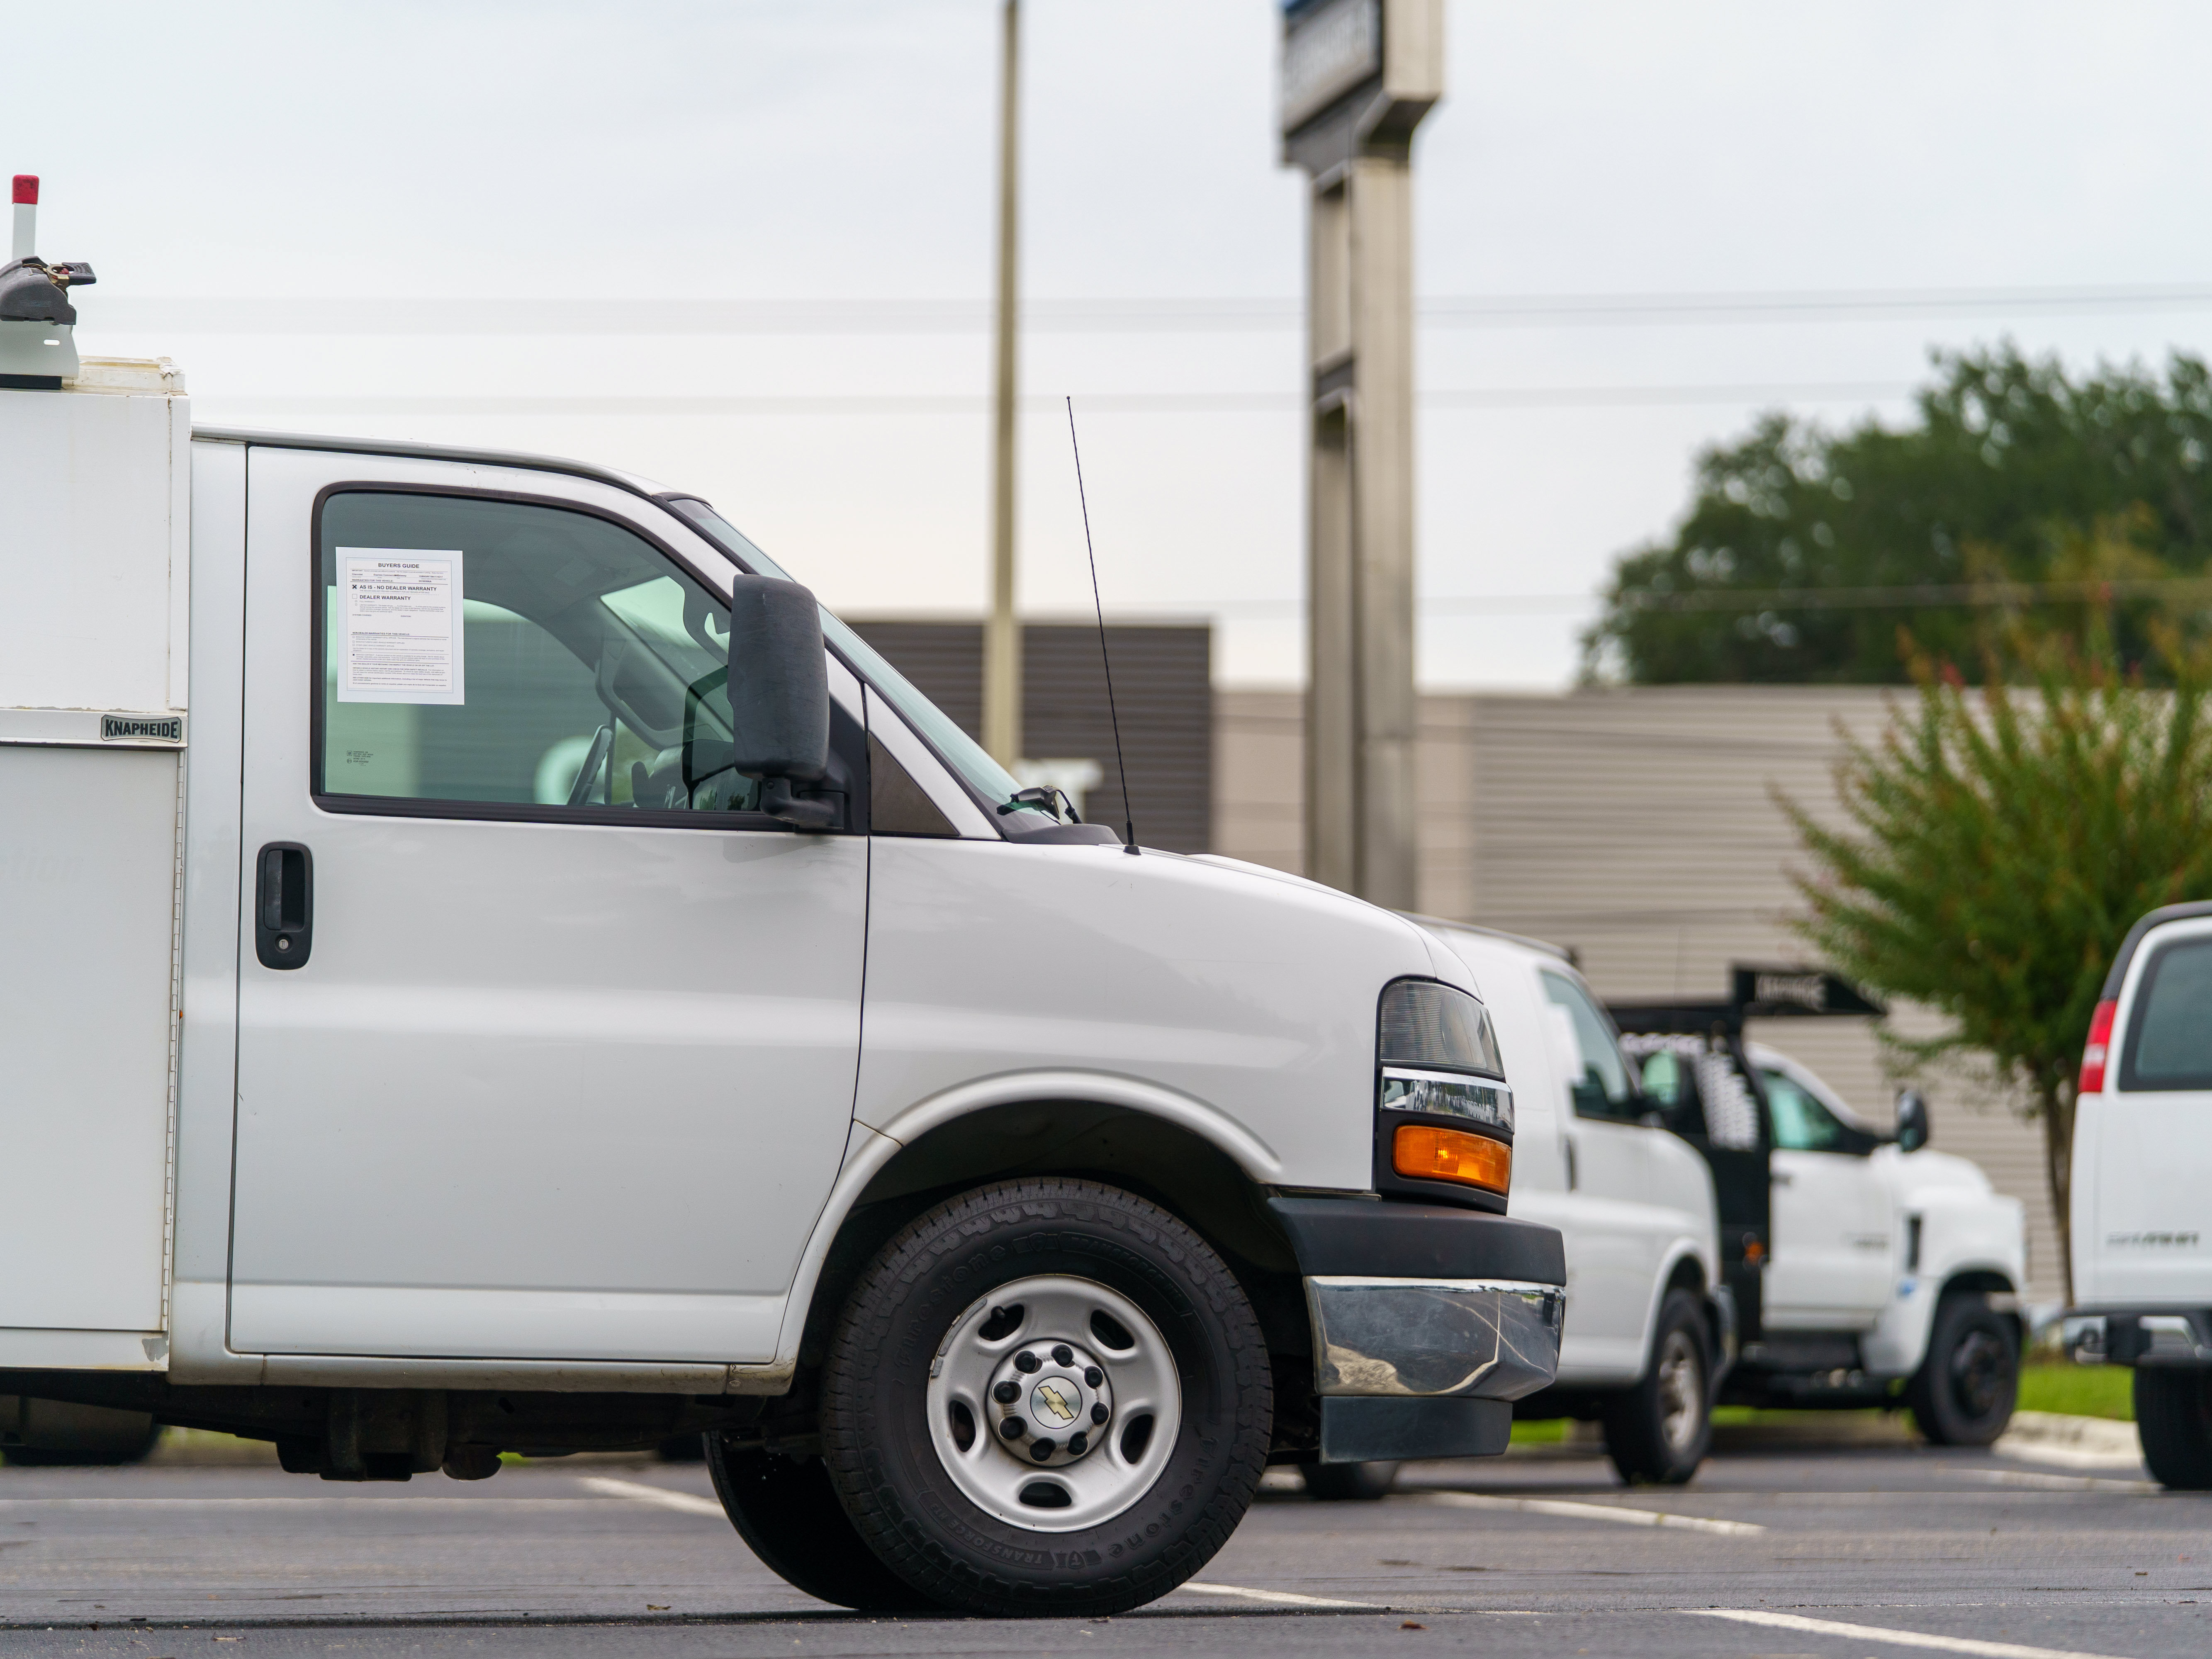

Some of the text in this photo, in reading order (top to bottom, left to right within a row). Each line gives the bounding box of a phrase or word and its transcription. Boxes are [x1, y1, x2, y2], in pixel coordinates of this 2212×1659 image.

[105, 719, 178, 739] KNAPHEIDE
[894, 1245, 1006, 1368] Firestone
[1108, 1437, 1218, 1558] Firestone
[949, 1518, 1043, 1565] TRANSFORCE
